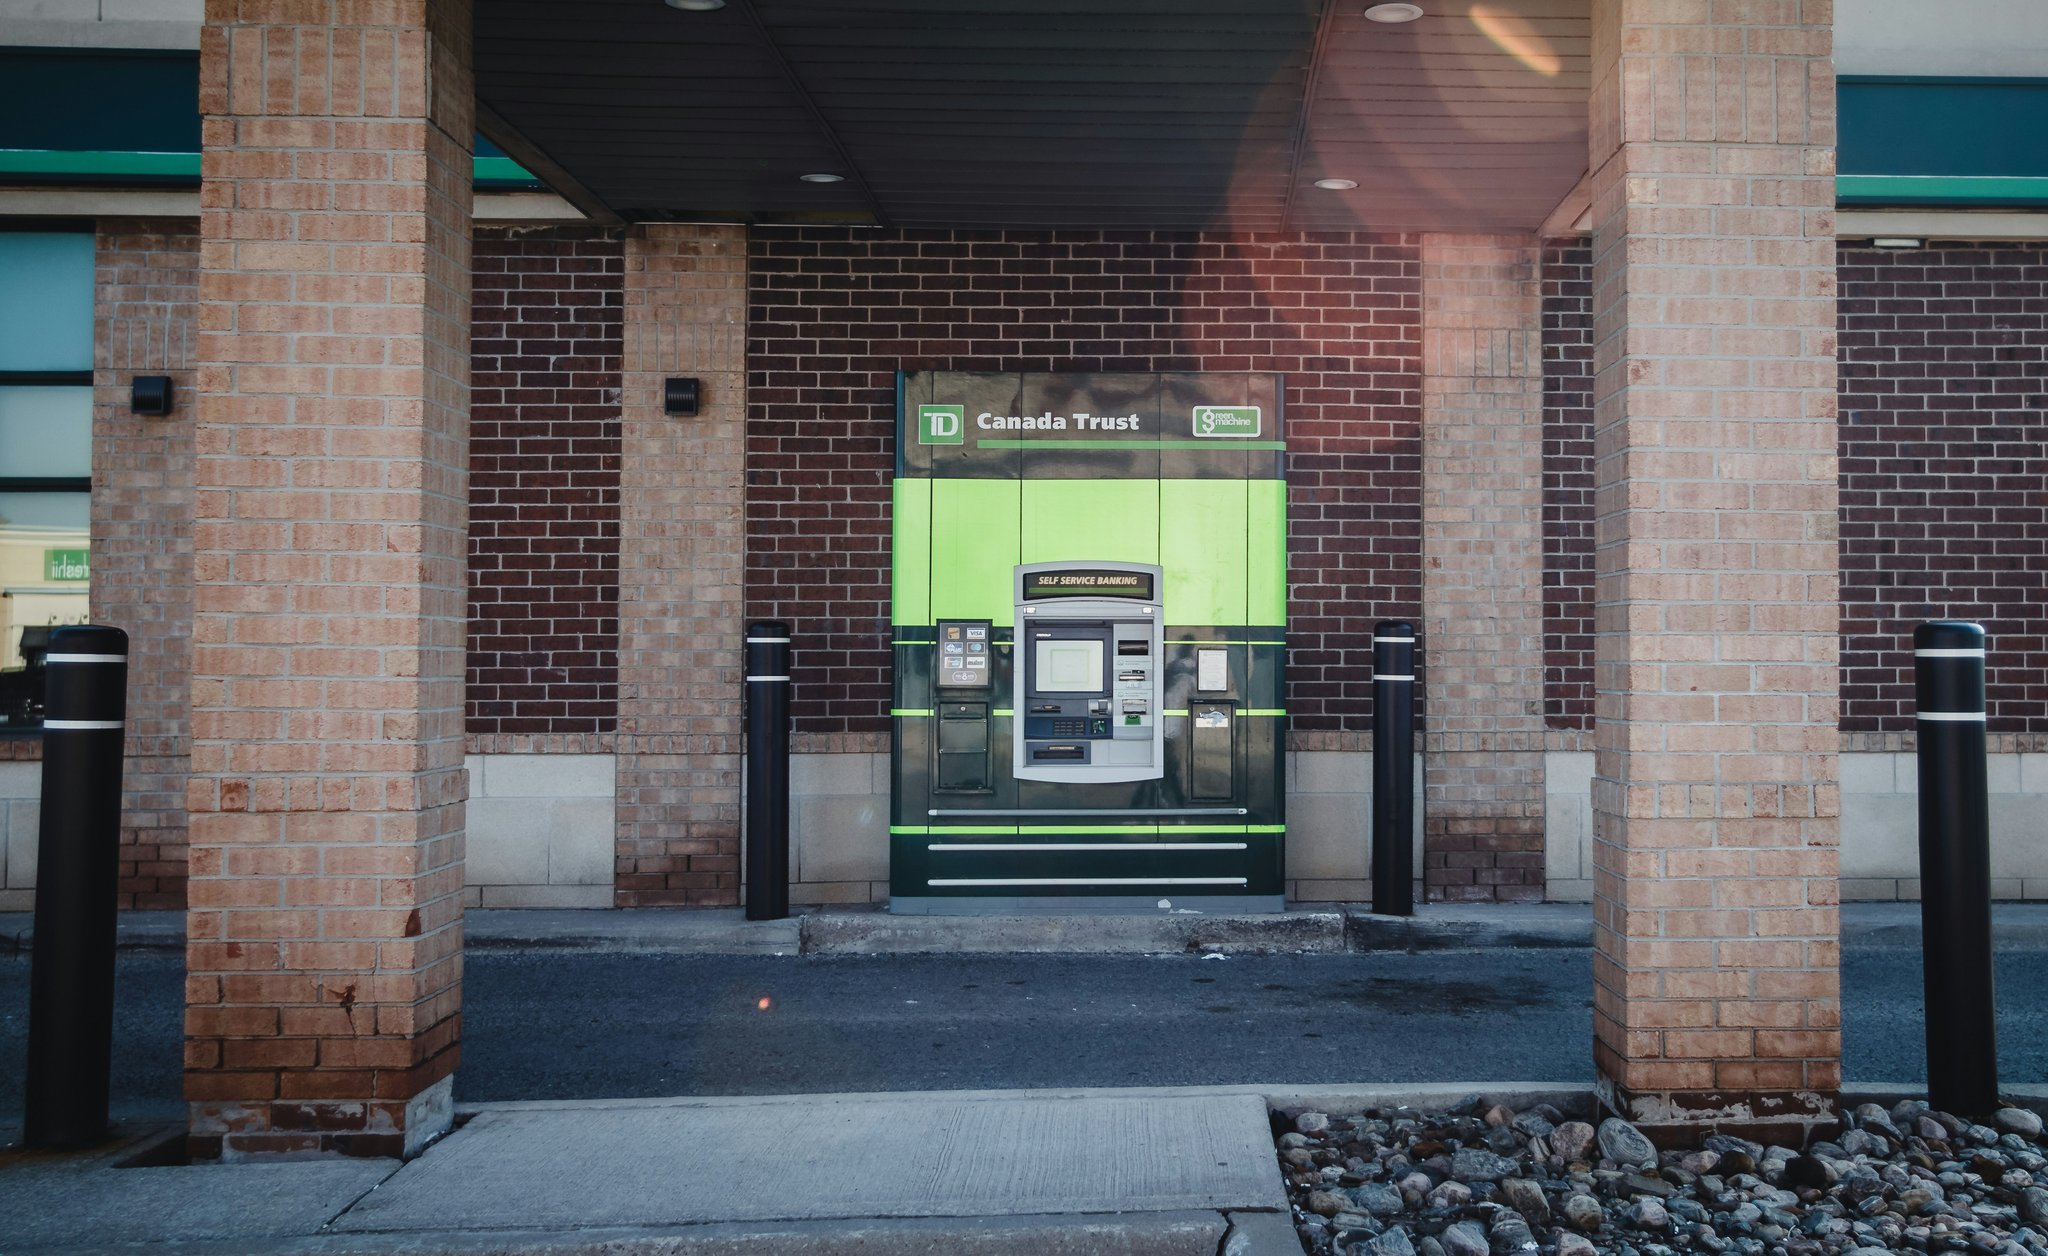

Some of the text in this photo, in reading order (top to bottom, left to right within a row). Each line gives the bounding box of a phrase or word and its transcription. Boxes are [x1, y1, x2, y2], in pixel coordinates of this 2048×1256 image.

[923, 412, 959, 436] TD
[976, 412, 1140, 431] Canada Trust
[1215, 417, 1251, 426] machine
[1038, 576, 1138, 585] SELF SERVICE BANKING
